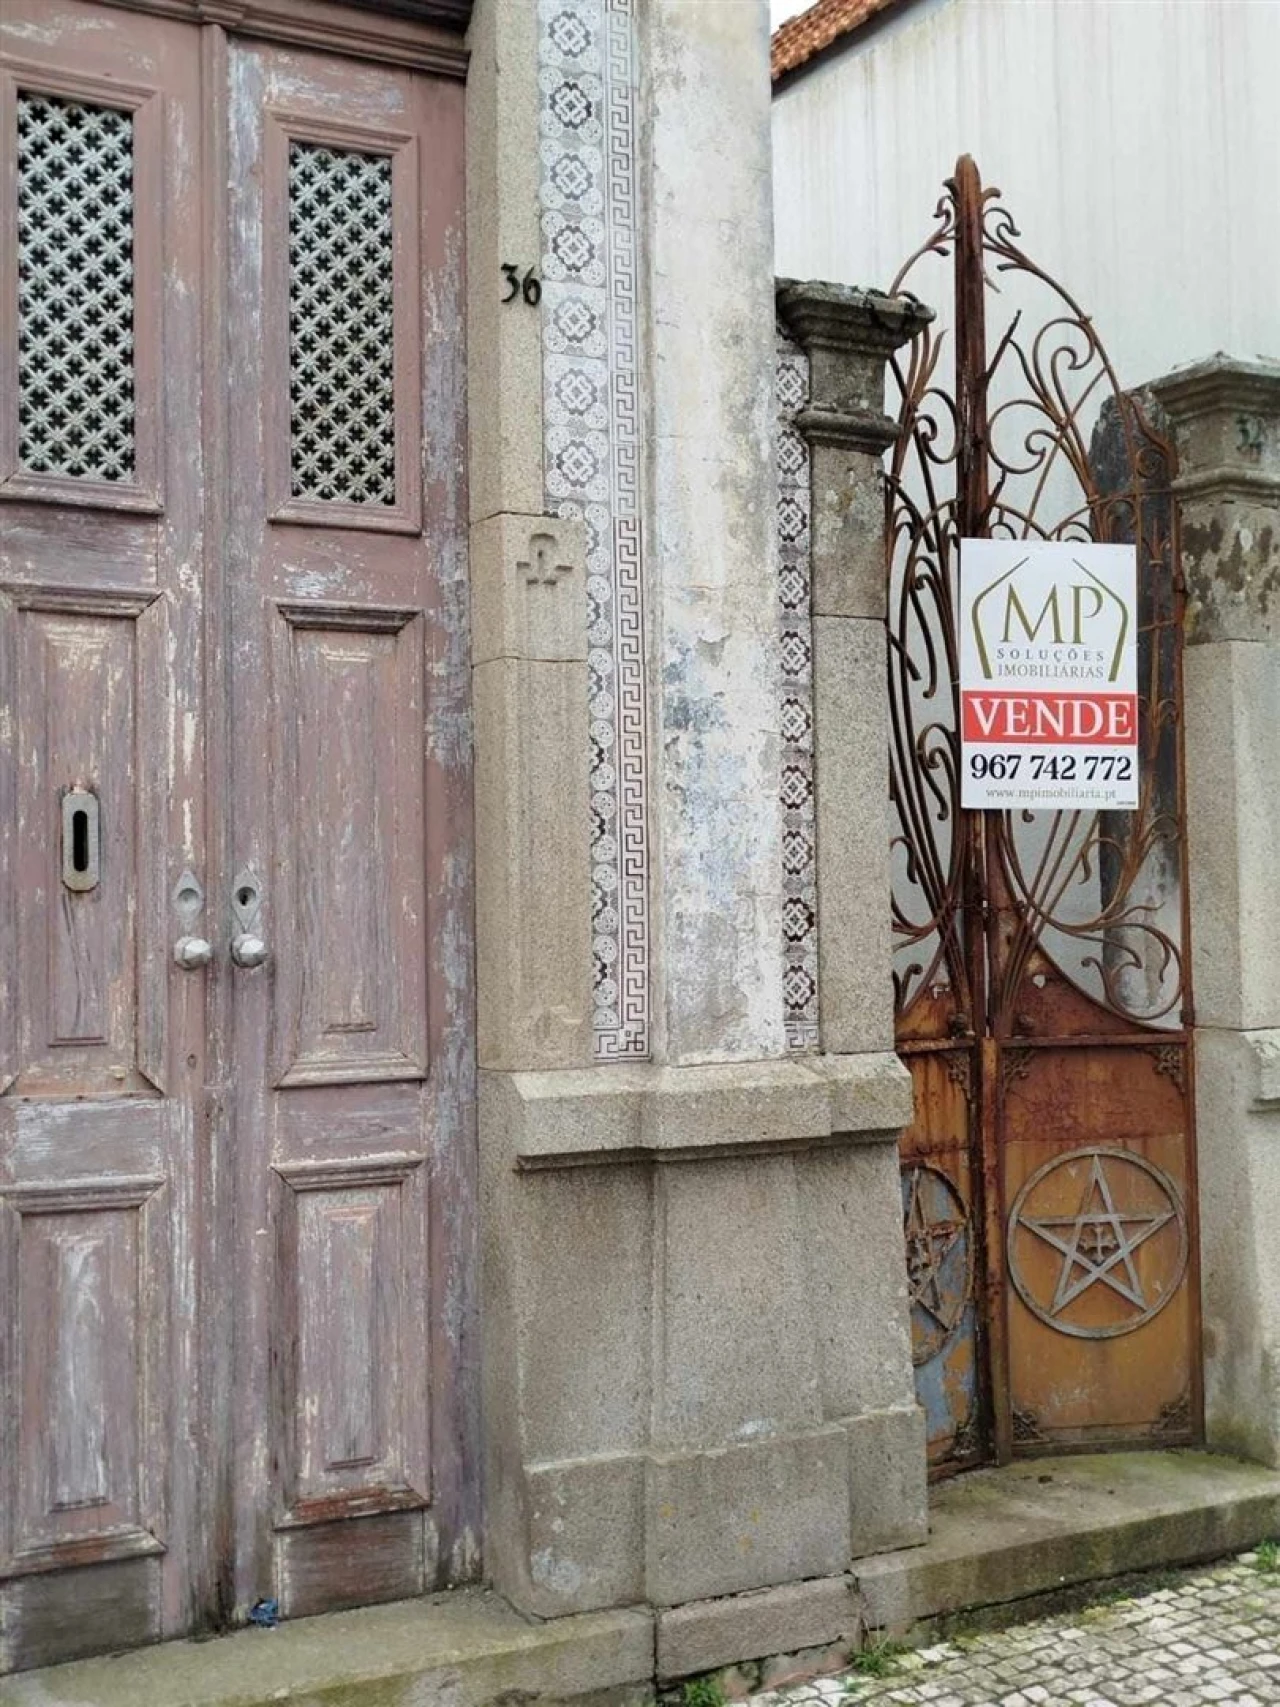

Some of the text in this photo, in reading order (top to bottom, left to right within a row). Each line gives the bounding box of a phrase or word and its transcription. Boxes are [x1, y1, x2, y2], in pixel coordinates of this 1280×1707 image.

[500, 262, 542, 306] 36
[999, 583, 1104, 645] MP
[996, 647, 1104, 663] SOLUÇÕES
[998, 661, 1104, 678] IMOBILIÁRIAS
[968, 697, 1133, 738] VENDE
[970, 753, 1132, 781] 967 742 772
[986, 786, 1117, 801] www.mpimobiliaria.pt
